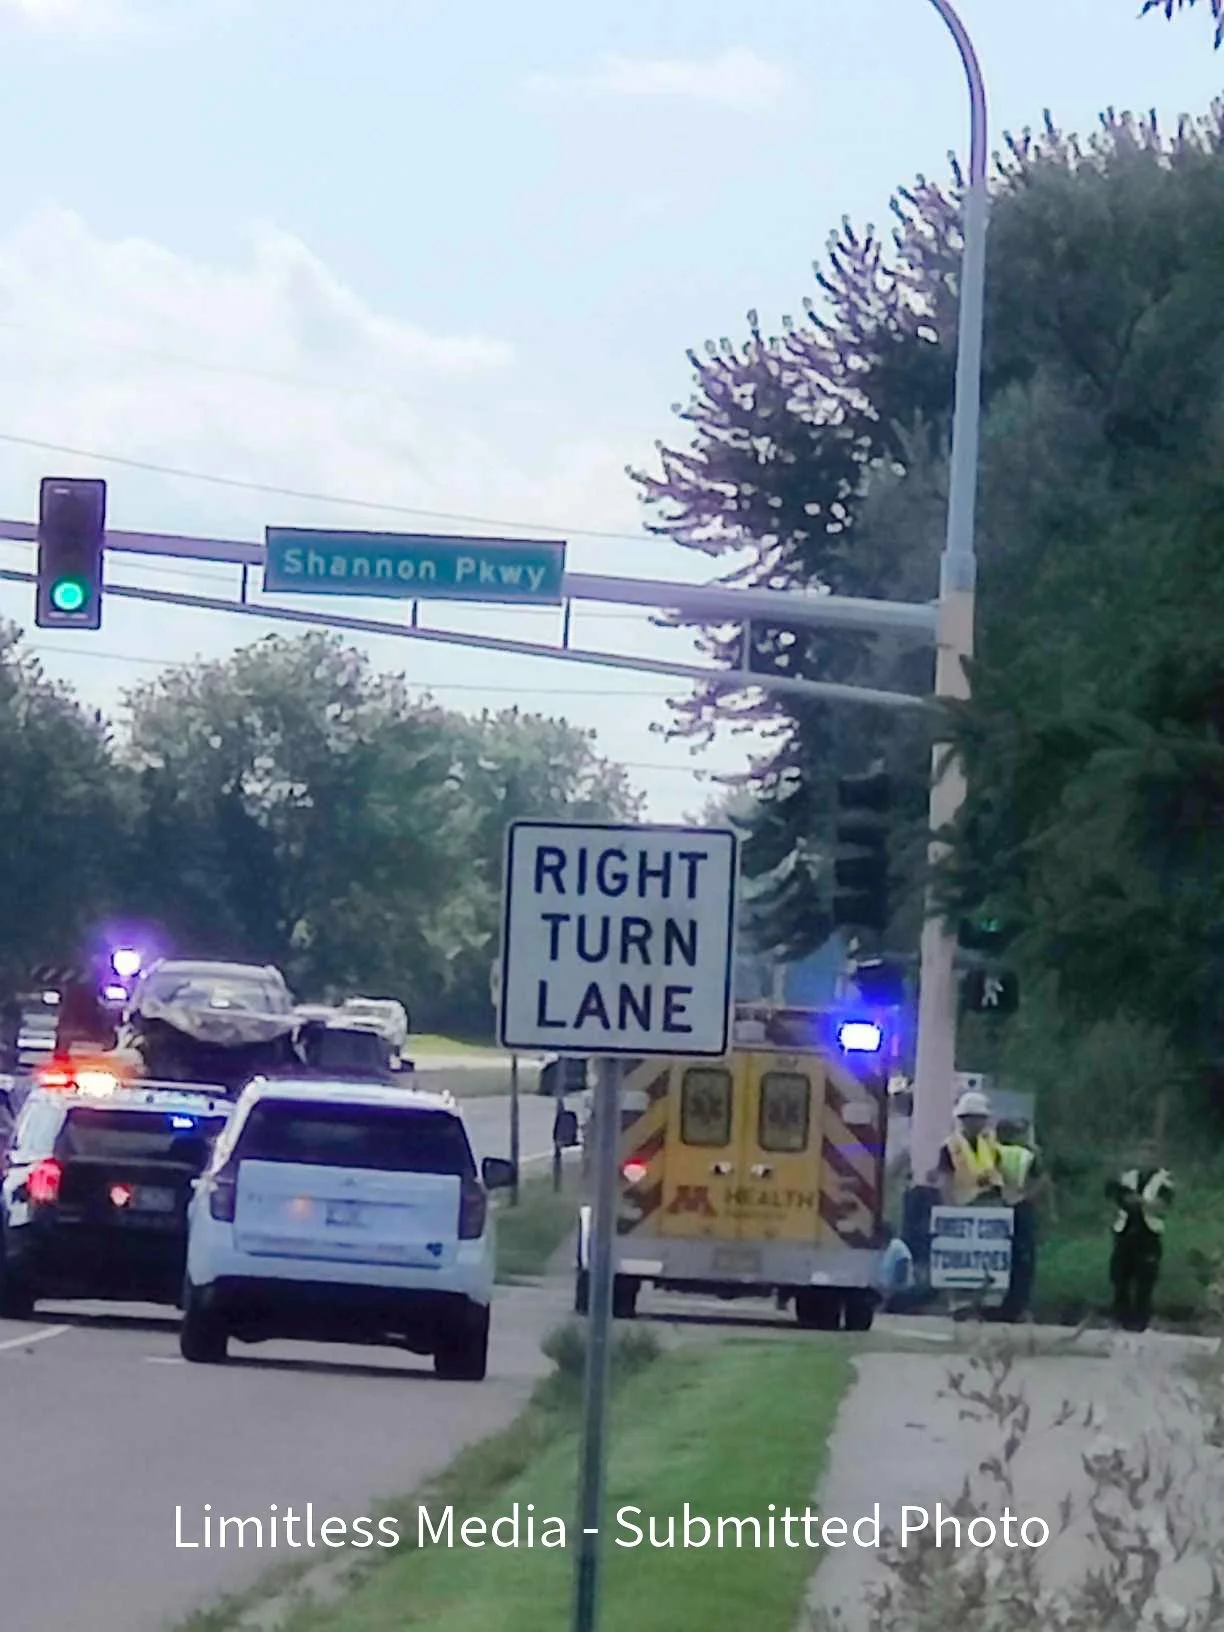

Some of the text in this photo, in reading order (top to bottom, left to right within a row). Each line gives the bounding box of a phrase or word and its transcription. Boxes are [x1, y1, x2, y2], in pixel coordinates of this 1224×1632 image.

[284, 547, 545, 591] Shannon Pkwy
[534, 845, 708, 899] RIGHT
[540, 913, 698, 967] TURN
[536, 979, 694, 1034] LANE
[725, 1185, 815, 1208] HEALTH
